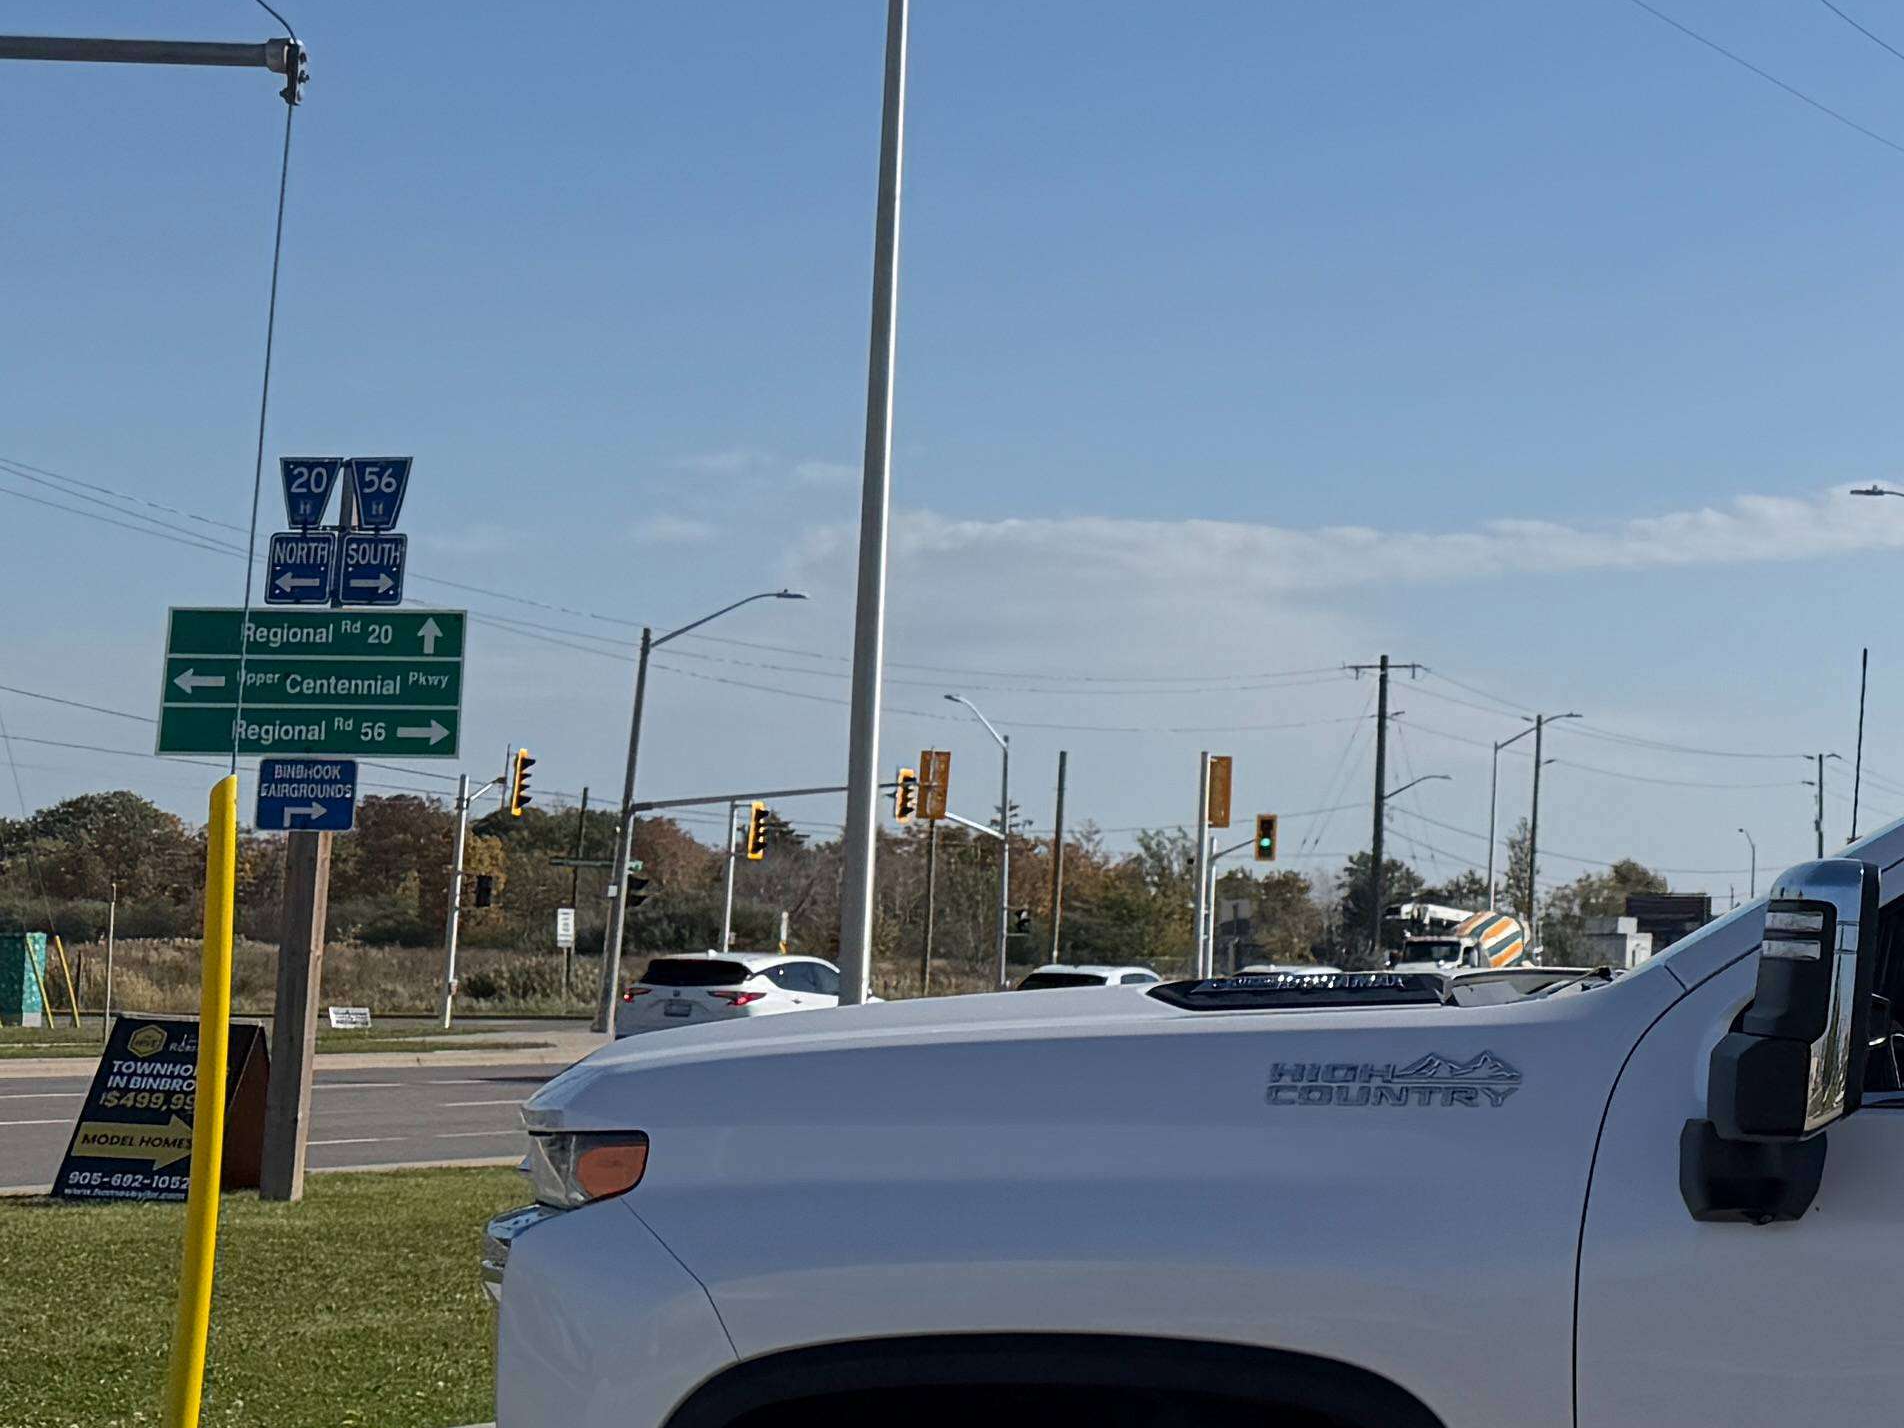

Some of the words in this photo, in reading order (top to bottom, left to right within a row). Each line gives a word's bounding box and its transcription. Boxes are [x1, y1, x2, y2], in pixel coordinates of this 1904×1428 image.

[290, 467, 328, 493] 20
[363, 467, 398, 493] 56
[274, 542, 329, 564] NORTH
[347, 543, 401, 565] SOUTH
[240, 622, 333, 648] Regional
[341, 620, 361, 634] Rd
[368, 624, 393, 644] 20
[286, 674, 400, 695] Centennial
[408, 672, 449, 688] Pkwy
[231, 720, 325, 745] Regional
[334, 717, 354, 731] Rd
[360, 722, 386, 741] 56
[274, 764, 342, 780] BINBROOK
[261, 783, 352, 798] FAIRGROUNDS
[112, 1060, 198, 1077] TOWNHO
[1269, 1062, 1396, 1083] HIGH
[107, 1075, 123, 1089] IN
[1265, 1084, 1519, 1107] COUNTRY
[81, 1133, 135, 1147] MODEL
[139, 1136, 193, 1150] HOMES
